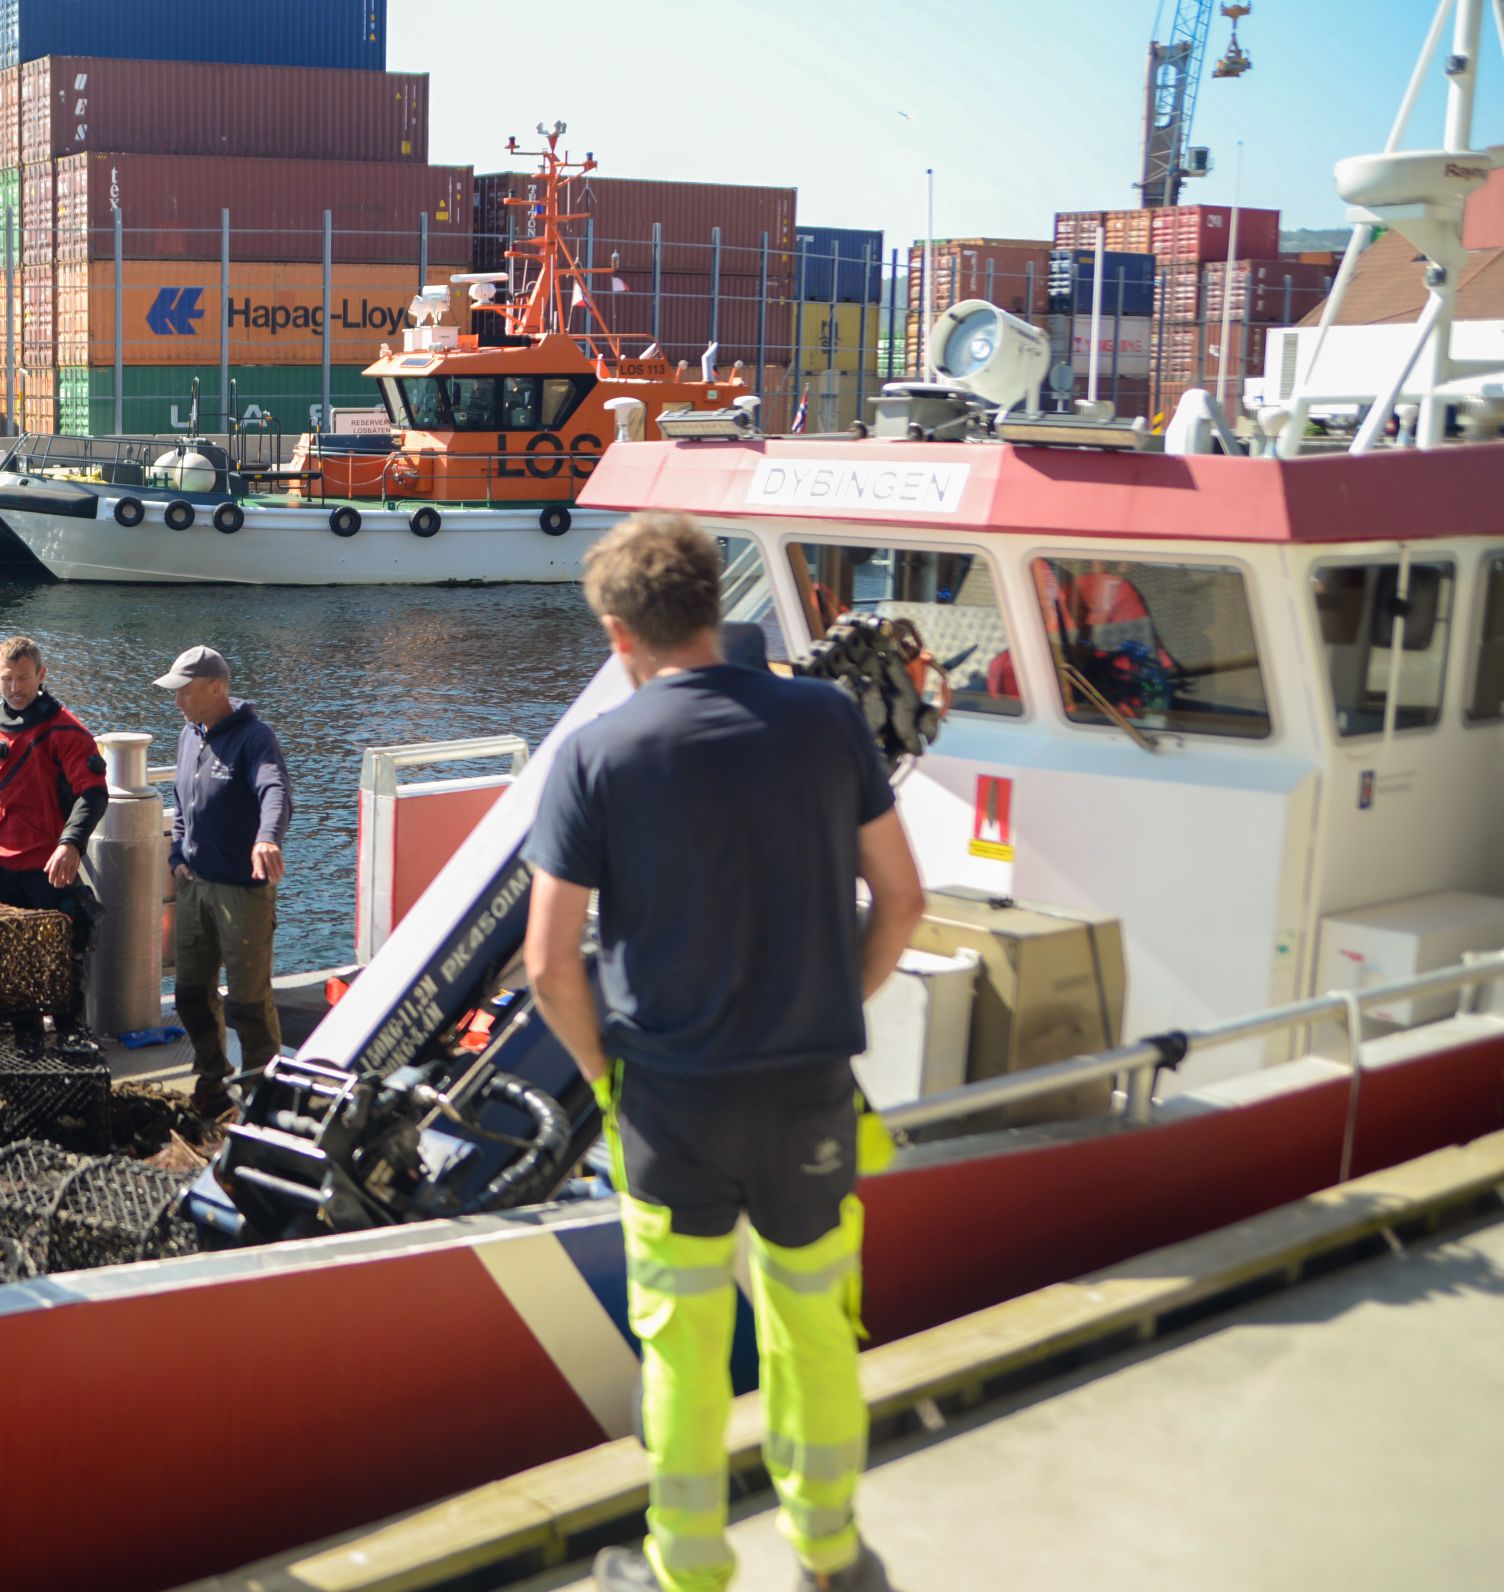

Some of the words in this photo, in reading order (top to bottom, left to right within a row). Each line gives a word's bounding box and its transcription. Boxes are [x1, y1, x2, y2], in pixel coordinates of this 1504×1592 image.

[620, 364, 643, 375] LOS
[647, 364, 666, 375] 113
[498, 433, 602, 479] LOS
[763, 468, 951, 501] DYBINGEN
